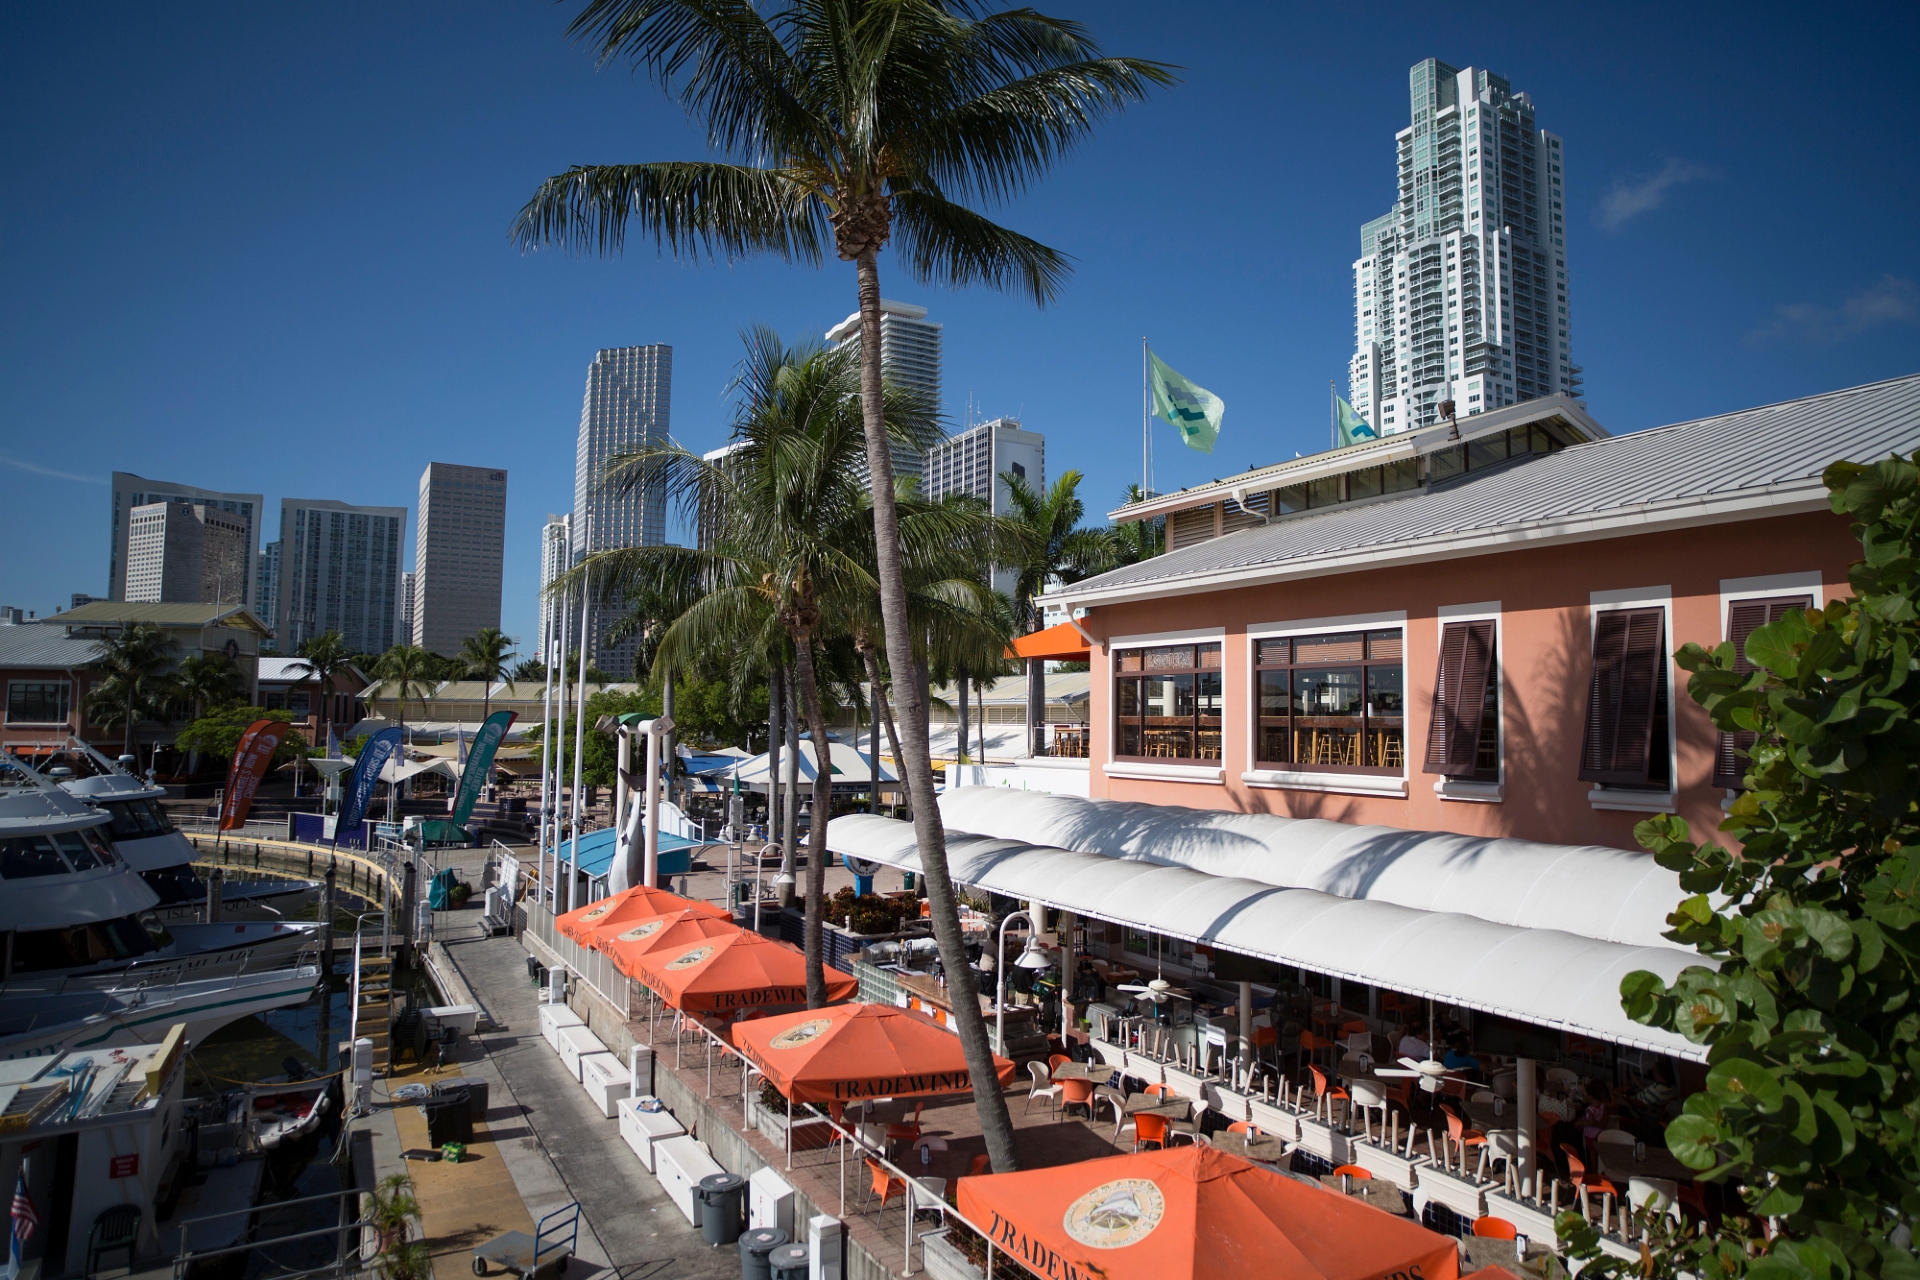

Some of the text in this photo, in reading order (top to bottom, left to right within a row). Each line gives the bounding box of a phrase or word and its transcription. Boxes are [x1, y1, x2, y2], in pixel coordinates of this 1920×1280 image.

[245, 752, 259, 769] ROW
[243, 776, 260, 799] CRUISE
[470, 767, 486, 792] CENTER
[712, 987, 809, 1008] TRADEWIN
[830, 1072, 973, 1099] TRADEWIND
